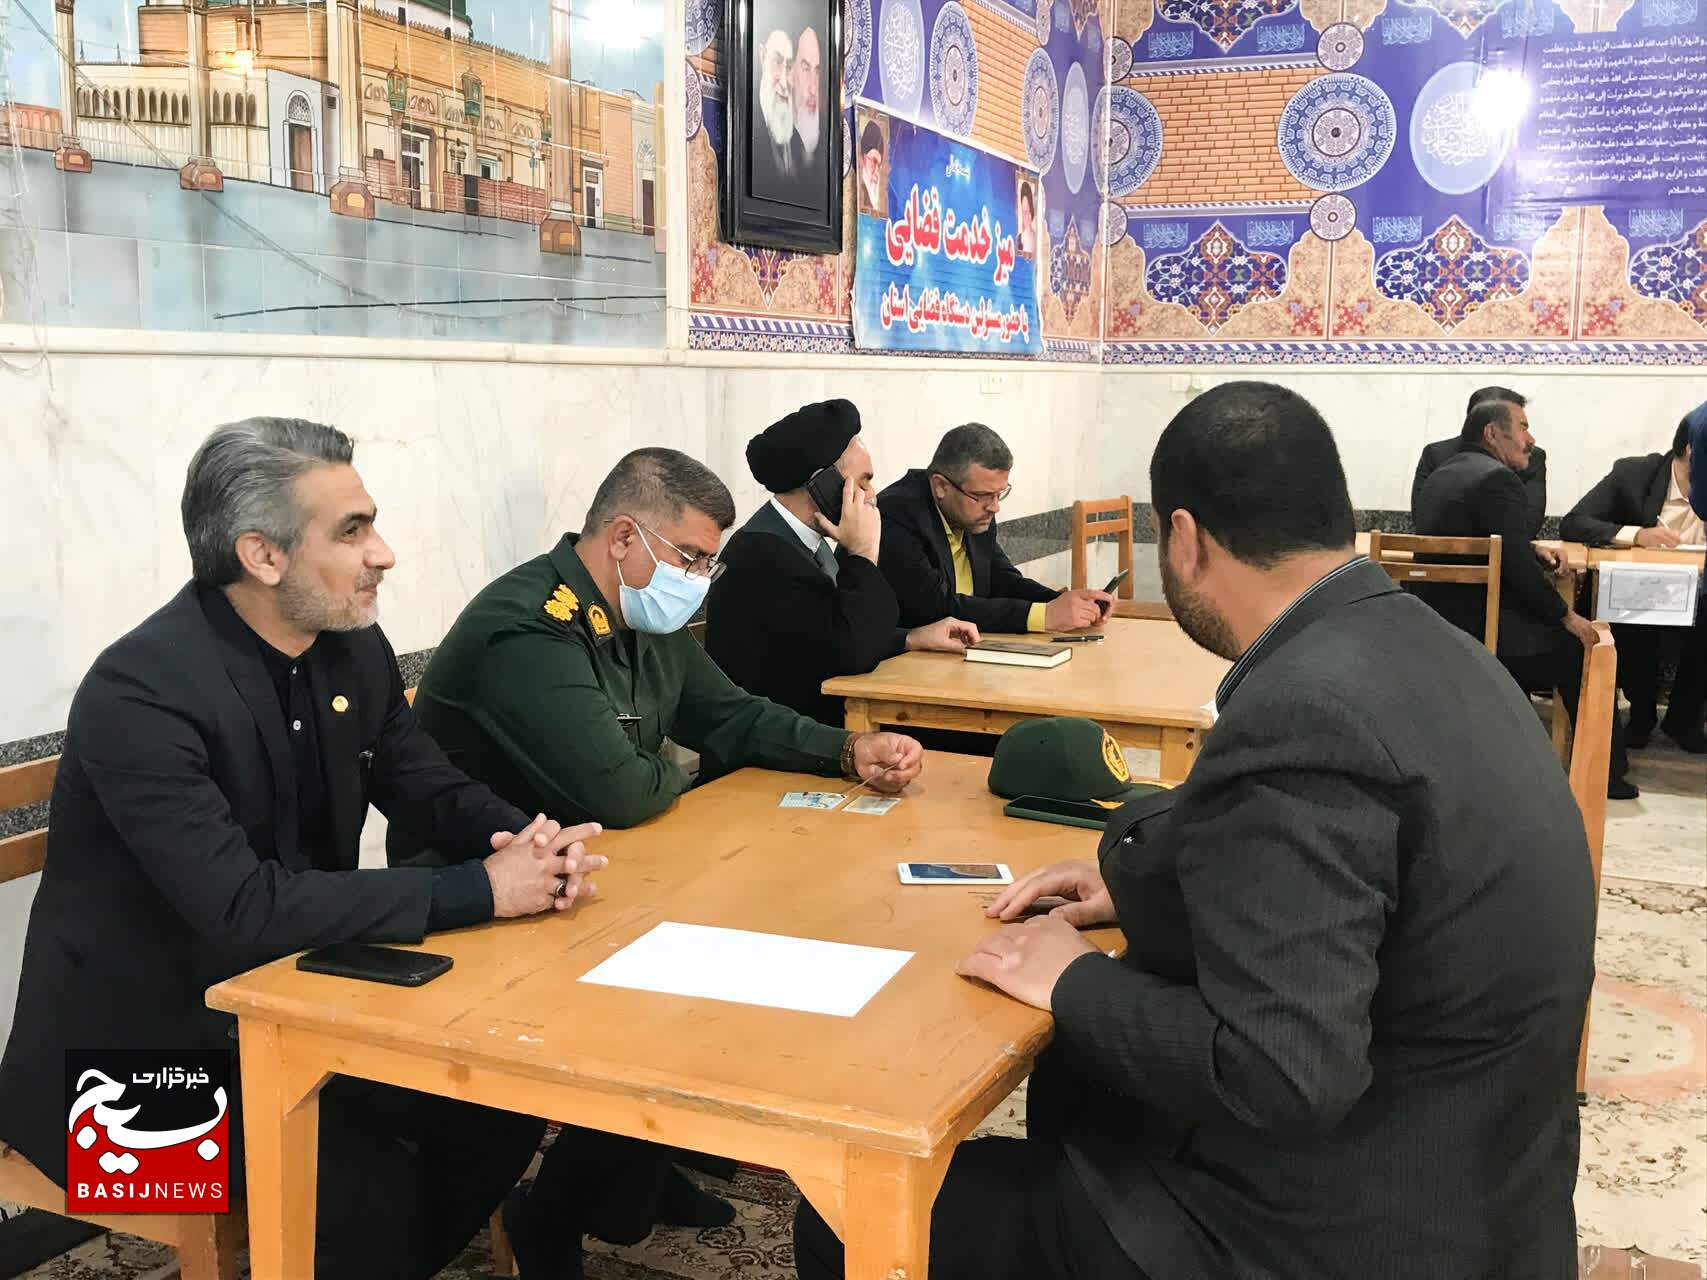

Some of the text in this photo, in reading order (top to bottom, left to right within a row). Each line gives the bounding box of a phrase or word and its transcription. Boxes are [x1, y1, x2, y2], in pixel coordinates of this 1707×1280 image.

[886, 184, 1014, 285] میز خدمت قضایی
[881, 281, 909, 329] استان
